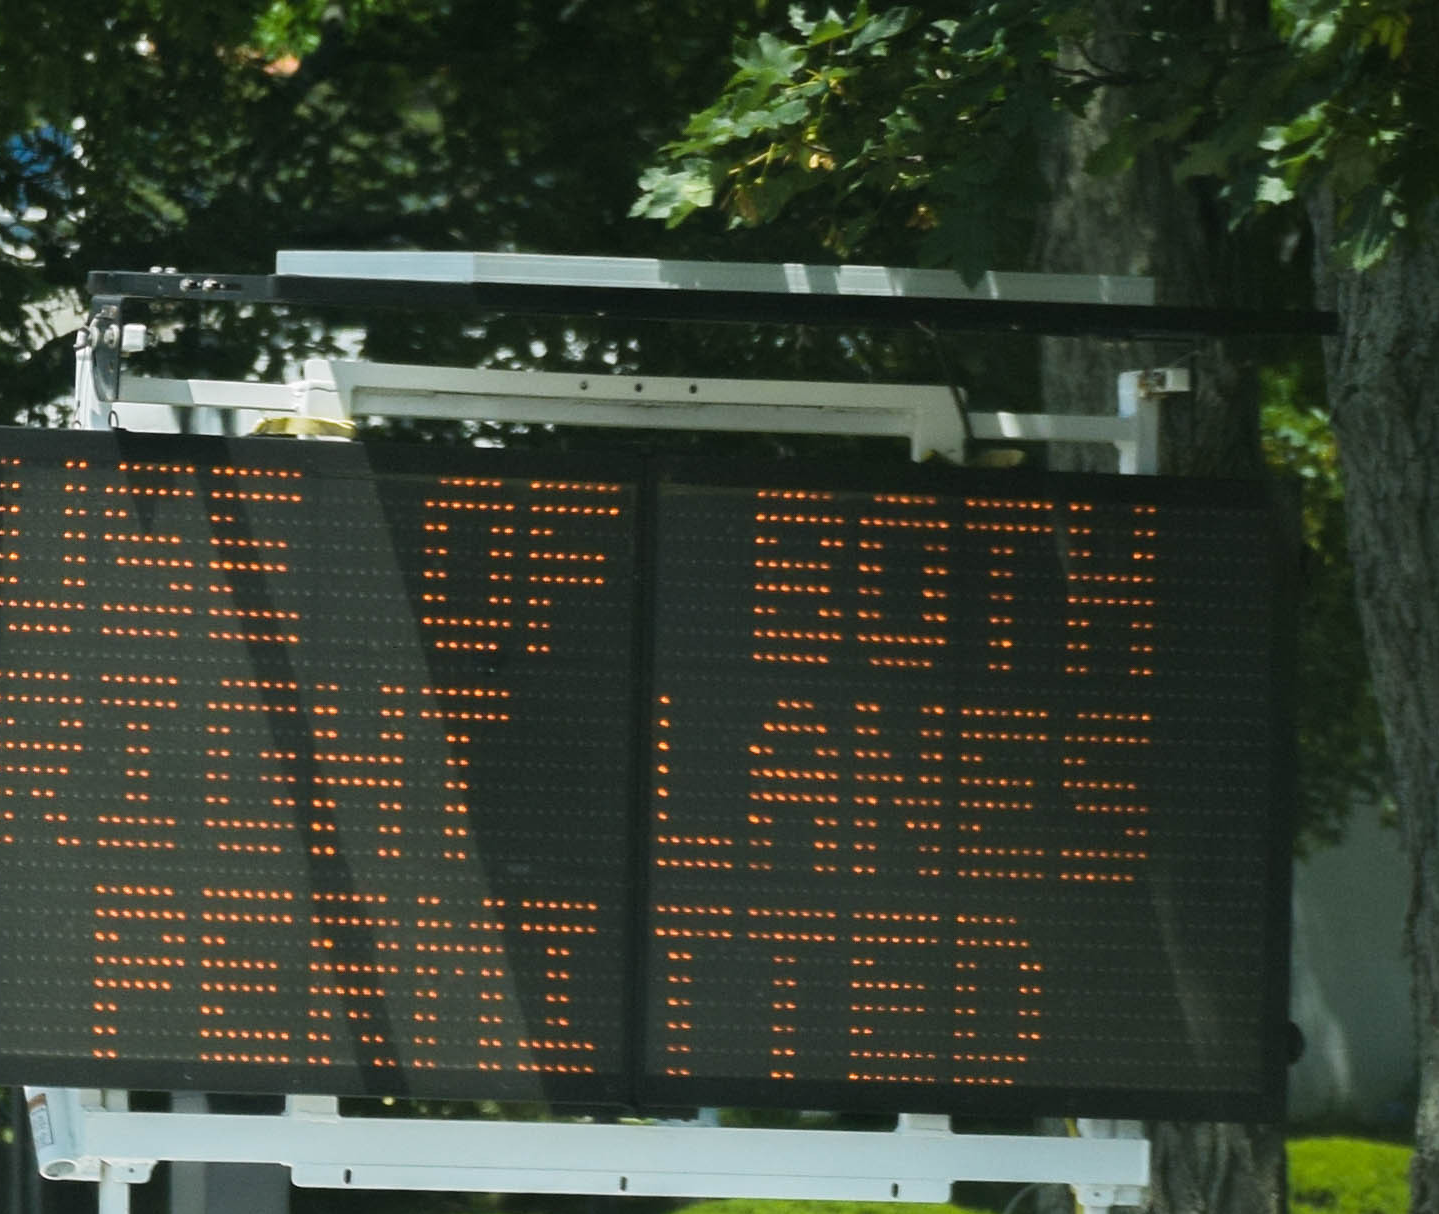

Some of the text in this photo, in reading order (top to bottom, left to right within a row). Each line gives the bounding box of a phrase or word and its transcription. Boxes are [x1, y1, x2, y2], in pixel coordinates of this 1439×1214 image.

[422, 478, 621, 653] OF
[753, 490, 1156, 676] BOTH
[657, 696, 1151, 881] LANES
